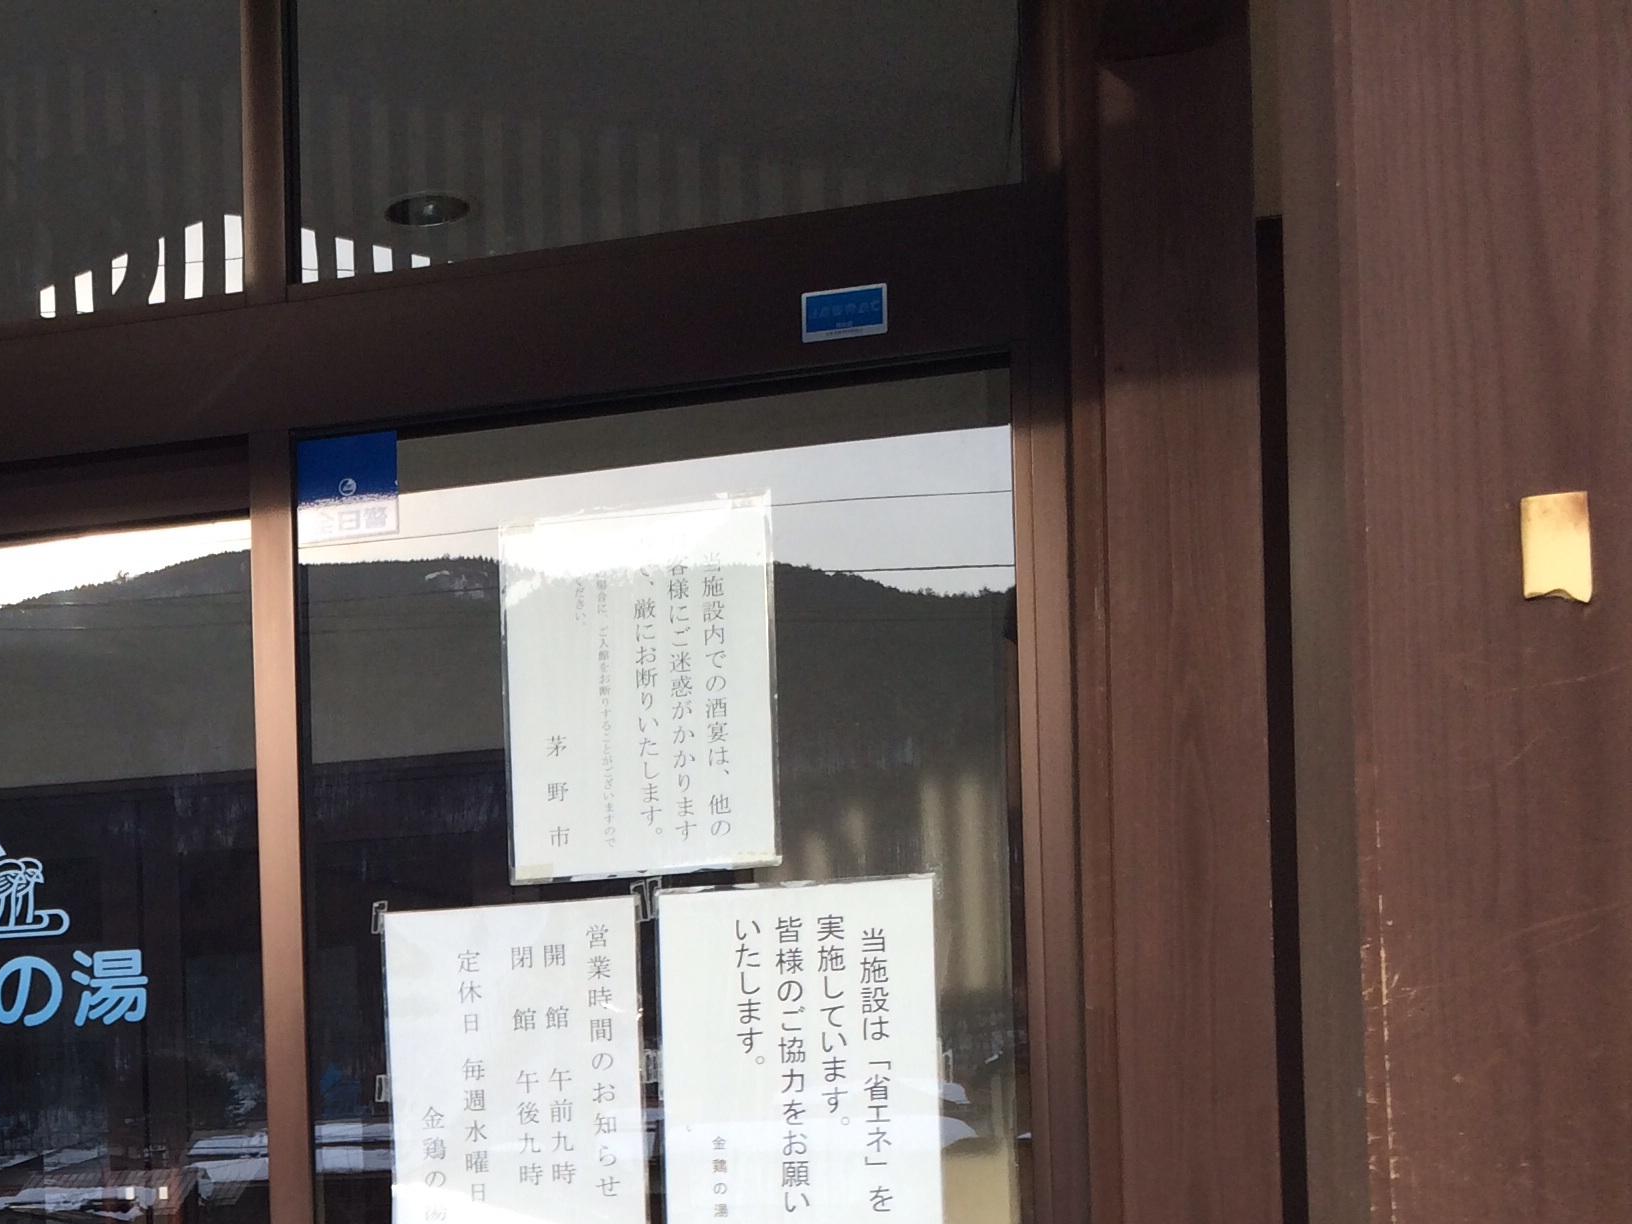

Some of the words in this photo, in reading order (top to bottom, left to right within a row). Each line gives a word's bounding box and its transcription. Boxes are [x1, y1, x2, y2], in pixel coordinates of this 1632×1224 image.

[585, 922, 621, 1198] 営業時間のお知らせ
[734, 918, 766, 1066] いたします。
[774, 915, 811, 1214] 皆様のご協力をお願い
[816, 913, 851, 1127] 実施しています。
[860, 926, 893, 1213] 当施設は「省エネ」を
